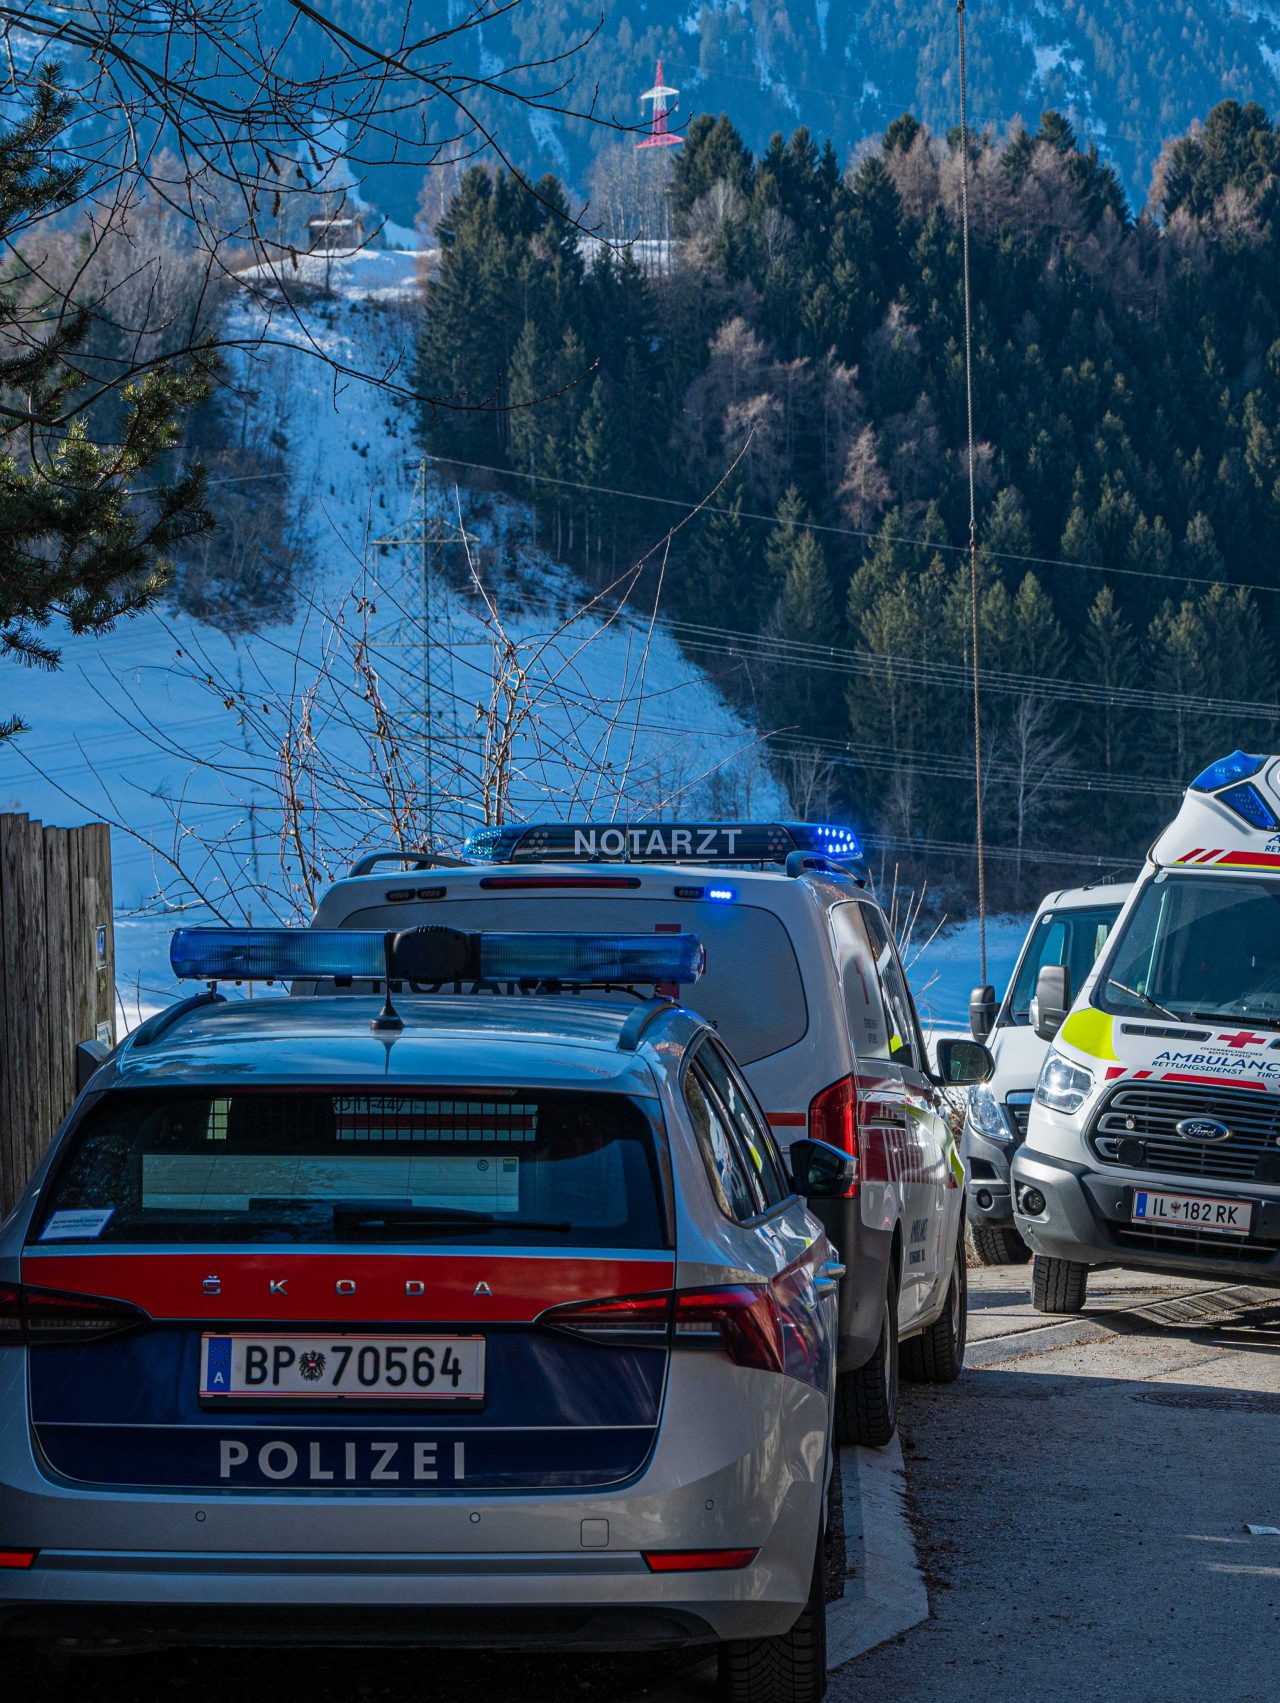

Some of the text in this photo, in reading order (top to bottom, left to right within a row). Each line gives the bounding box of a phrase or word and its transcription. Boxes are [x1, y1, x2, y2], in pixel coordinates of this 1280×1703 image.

[574, 829, 742, 855] NOTARZT
[1151, 1060, 1245, 1075] RETTUNGSDIENST
[1188, 1123, 1216, 1136] Ford
[1153, 1197, 1239, 1225] IL 182 RK
[202, 1275, 493, 1297] ŠKODA
[213, 1372, 224, 1384] A
[245, 1345, 462, 1387] BP 70564
[219, 1440, 465, 1480] POLIZEI
